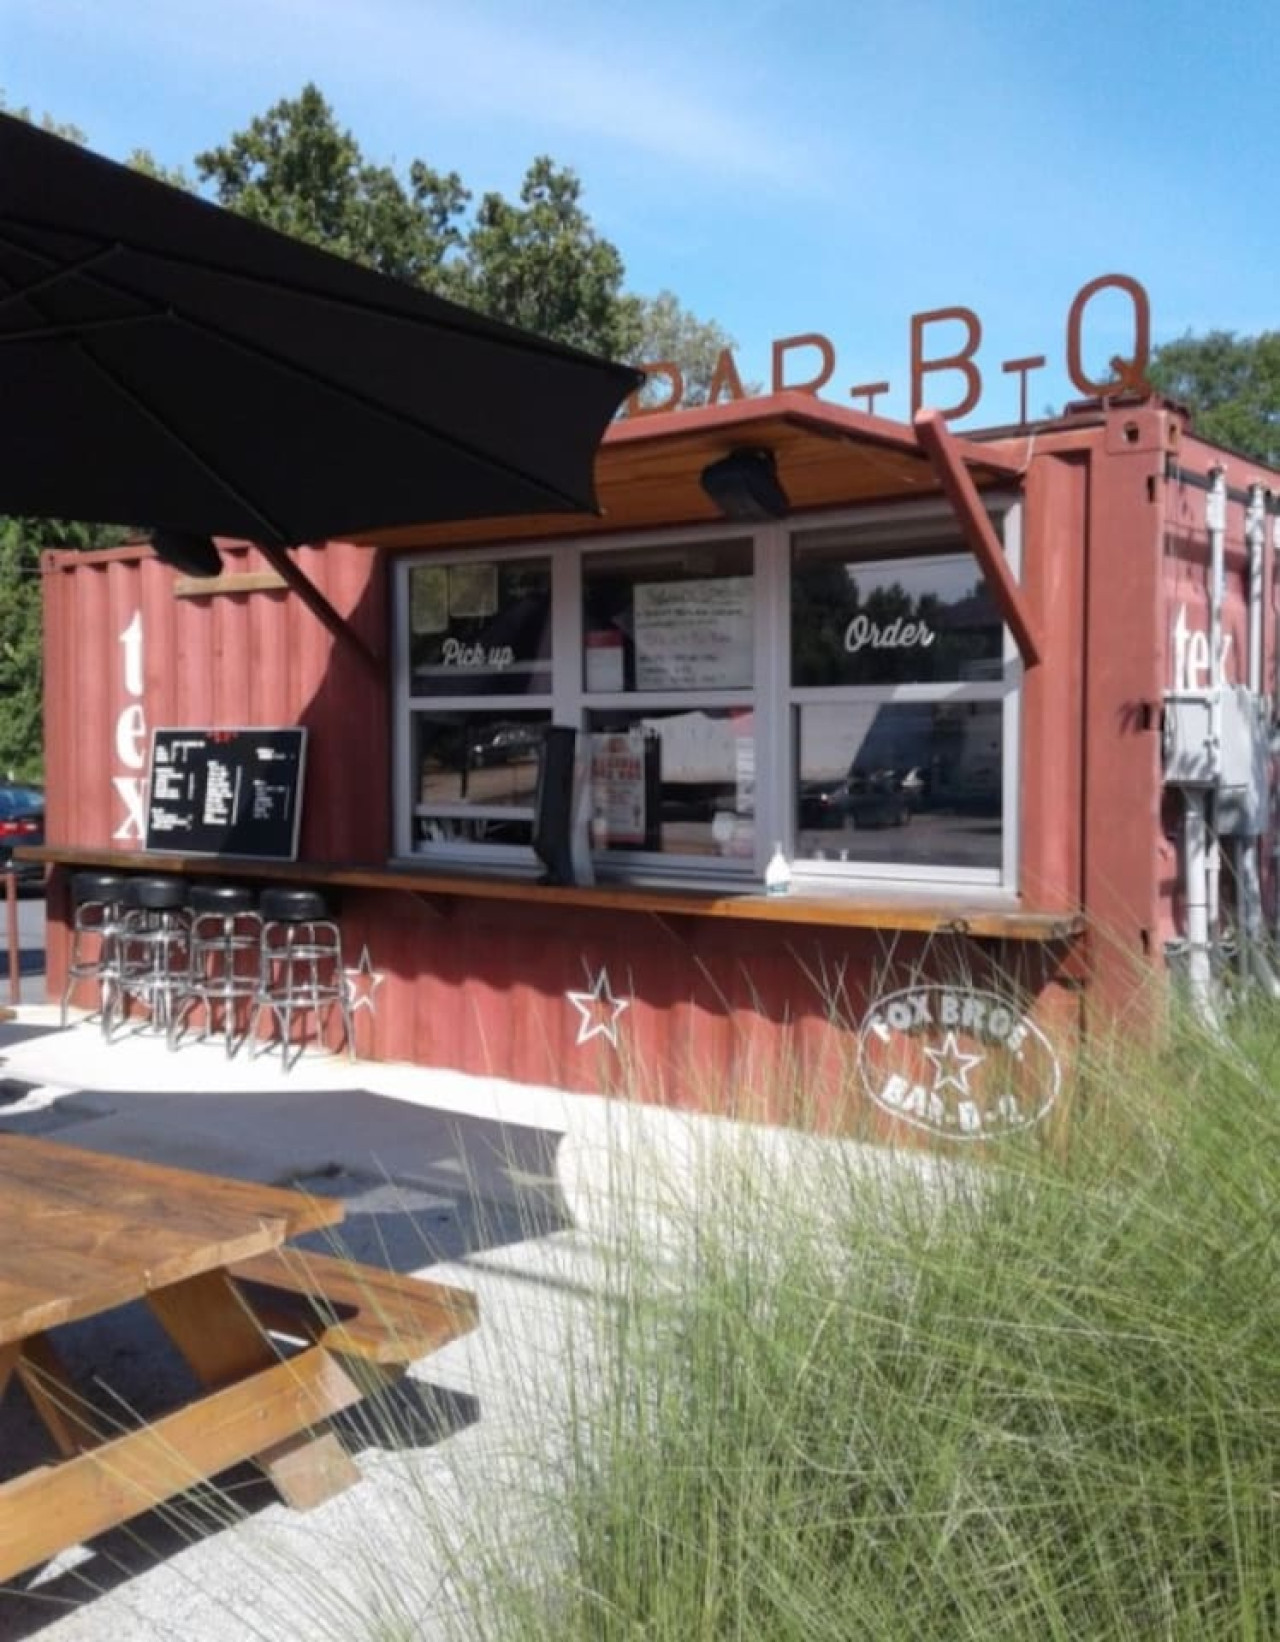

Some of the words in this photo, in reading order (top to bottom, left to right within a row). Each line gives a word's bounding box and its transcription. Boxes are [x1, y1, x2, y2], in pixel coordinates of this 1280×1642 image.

[845, 615, 934, 651] Order
[442, 637, 487, 667] Pick
[488, 645, 515, 671] up
[868, 993, 933, 1043] FOX
